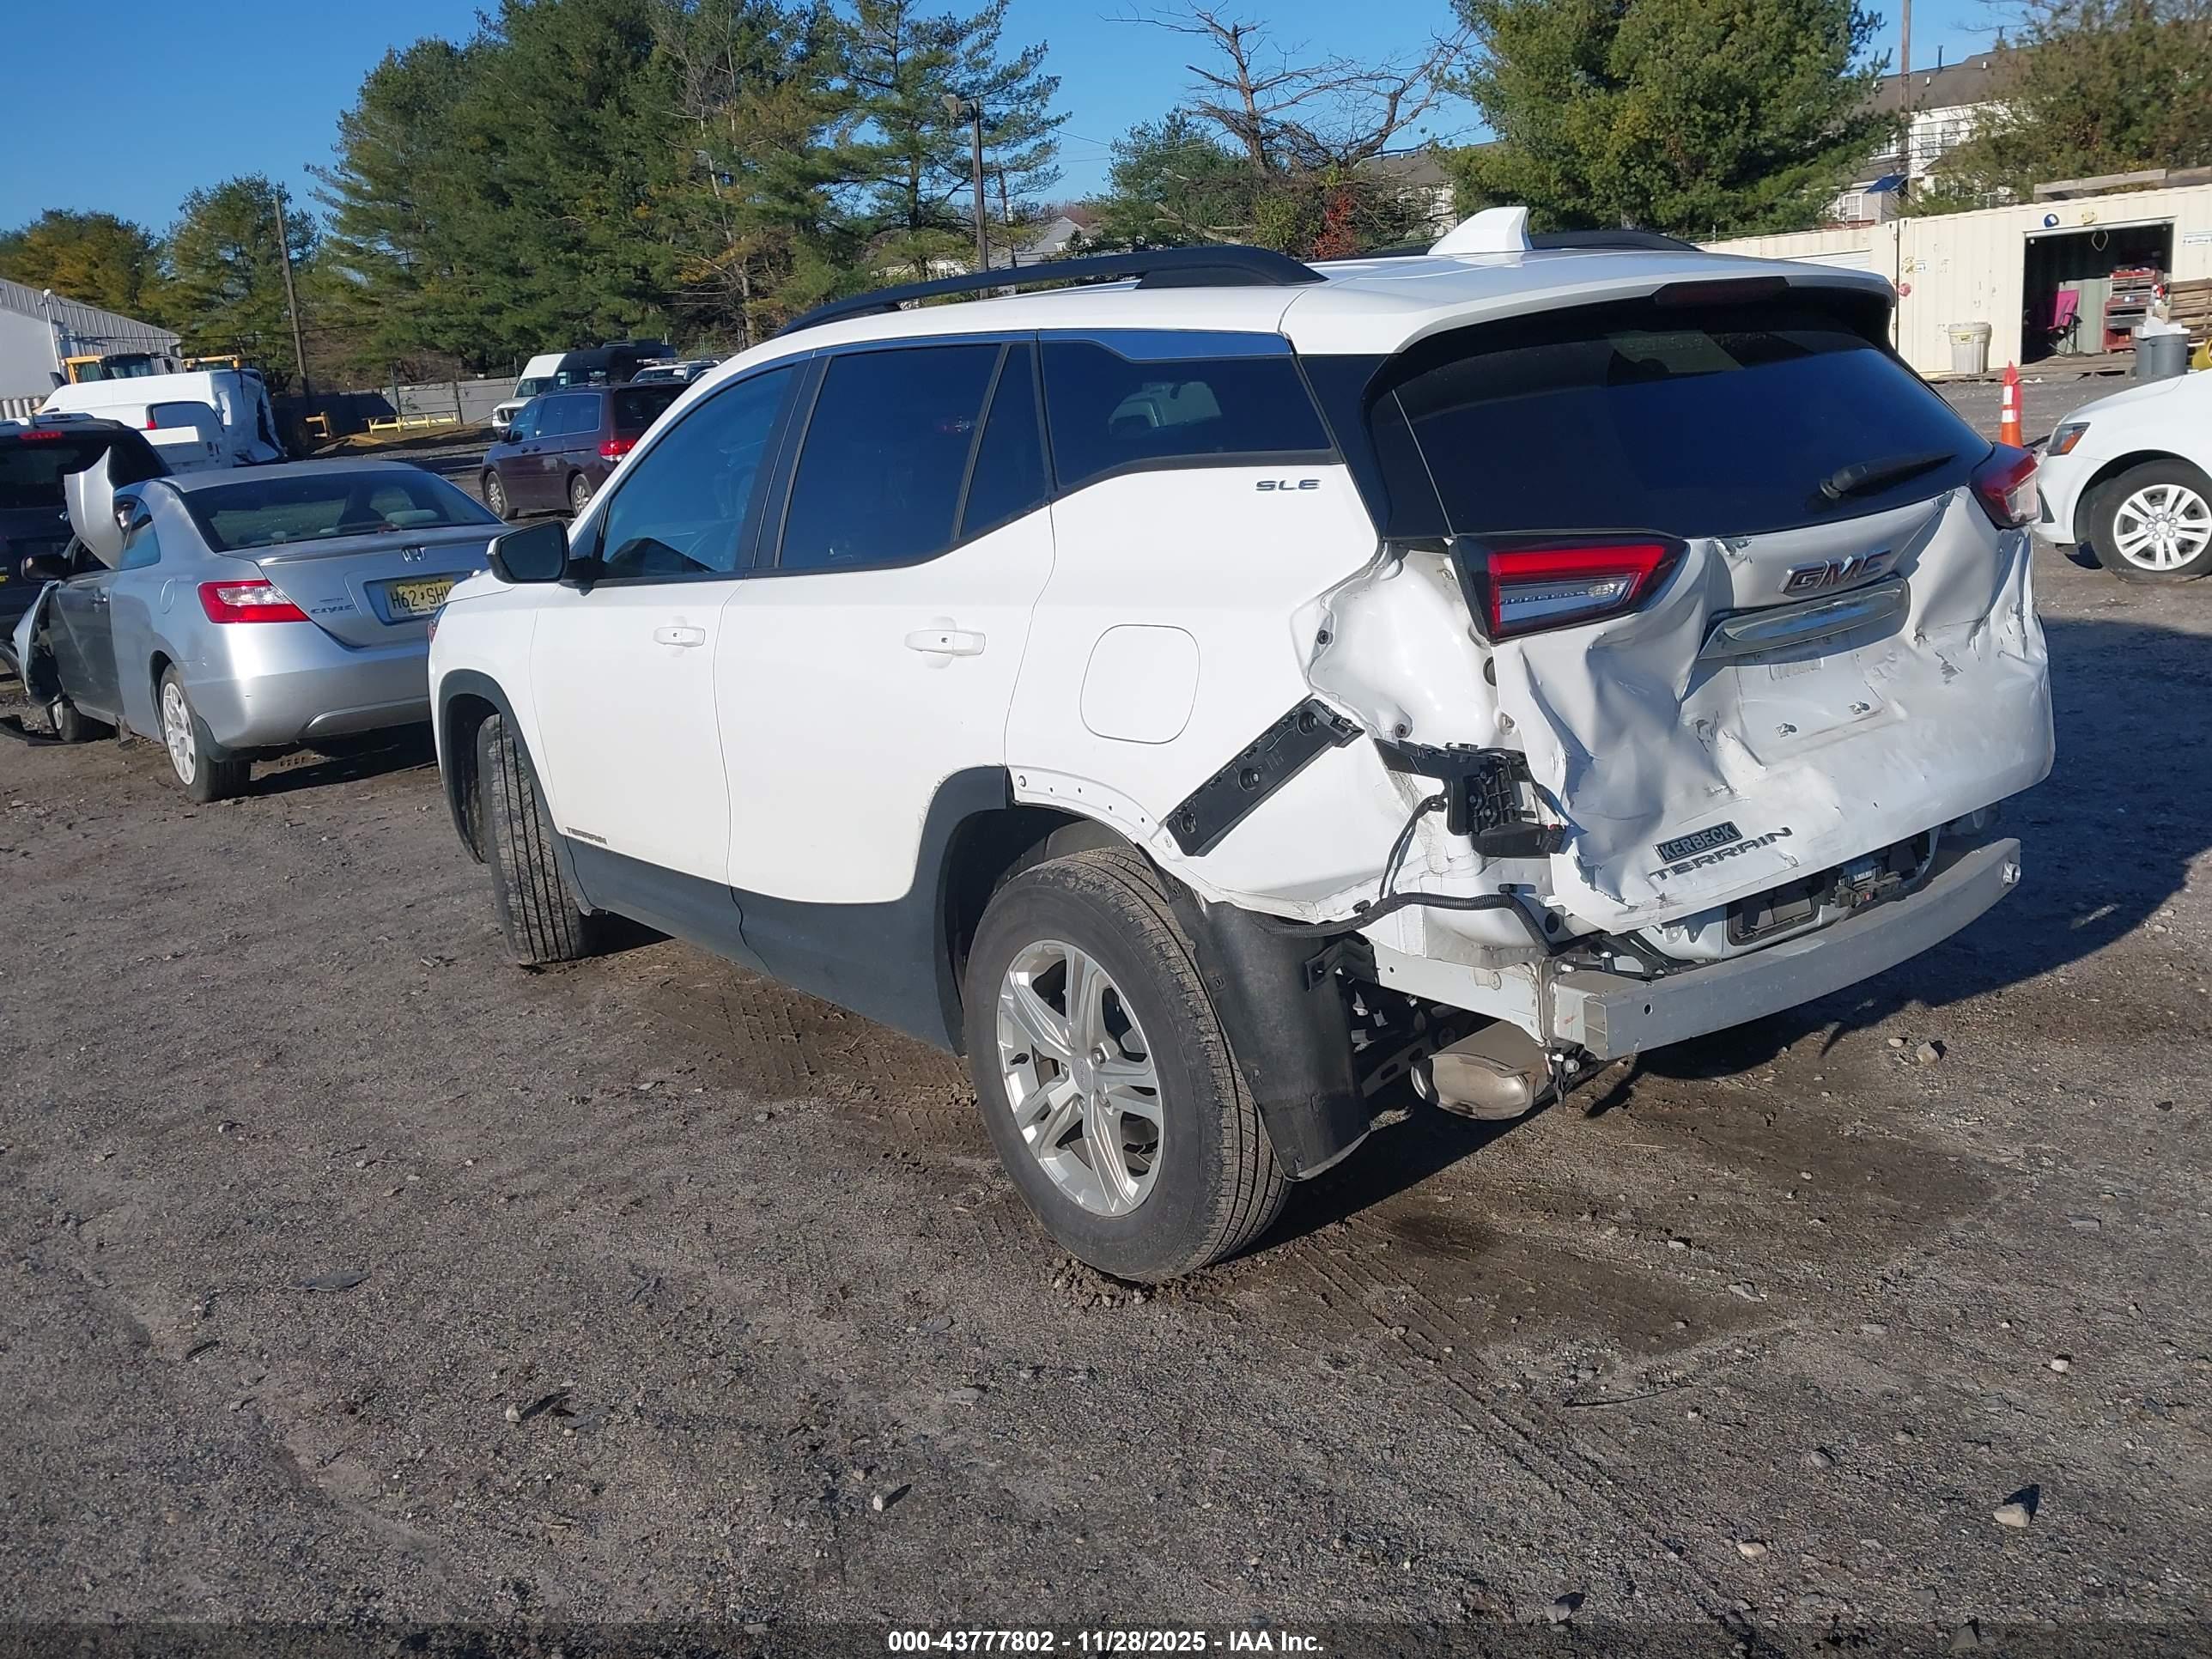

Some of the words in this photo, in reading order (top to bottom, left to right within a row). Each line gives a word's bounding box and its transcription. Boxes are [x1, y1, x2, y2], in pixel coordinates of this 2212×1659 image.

[1255, 479, 1322, 492] SLE
[1777, 548, 1892, 594] GMC
[309, 604, 355, 614] CIVIC
[1648, 826, 1793, 881] TERRAIN
[1659, 823, 1738, 861] KERBECK
